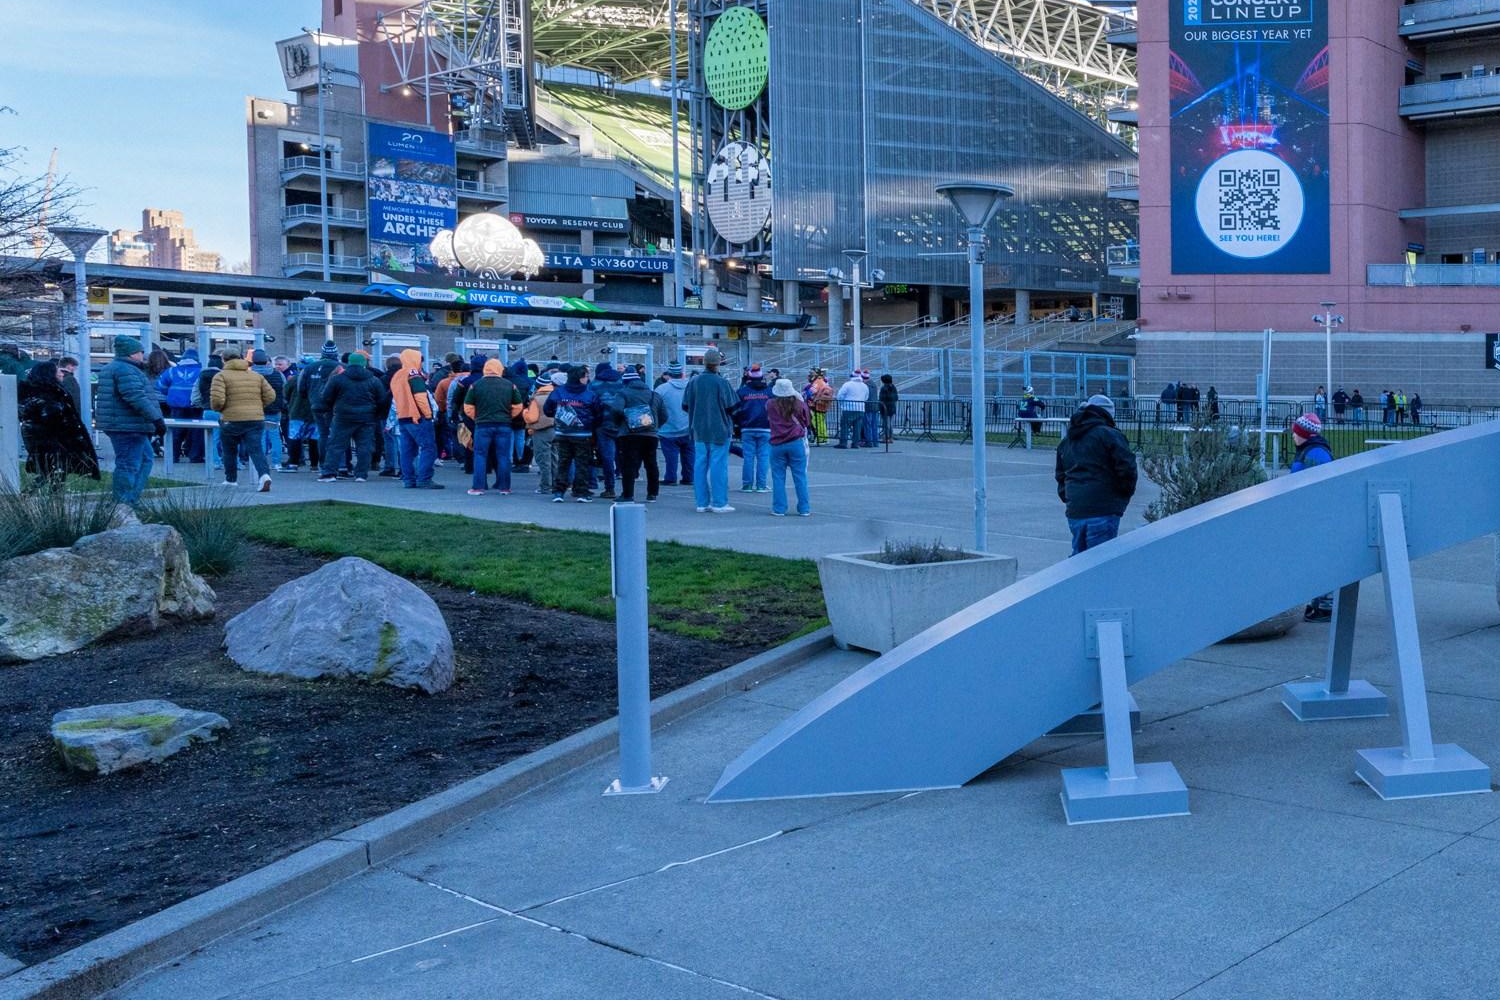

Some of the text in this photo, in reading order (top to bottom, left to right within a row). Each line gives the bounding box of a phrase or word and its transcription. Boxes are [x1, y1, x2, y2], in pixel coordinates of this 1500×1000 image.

[1211, 6, 1302, 19] LINEUP
[1184, 29, 1312, 41] OUR BIGGEST YEAR YET
[383, 205, 445, 217] MEMORIES ARE MADE
[383, 213, 445, 227] UNDER THESE
[525, 217, 624, 229] TOYOTA RESERVE CLUB
[1219, 234, 1280, 242] SEE YOU HERE!
[544, 255, 583, 266] ELTA
[455, 280, 529, 292] muckleshoot
[470, 292, 518, 304] NW GATE
